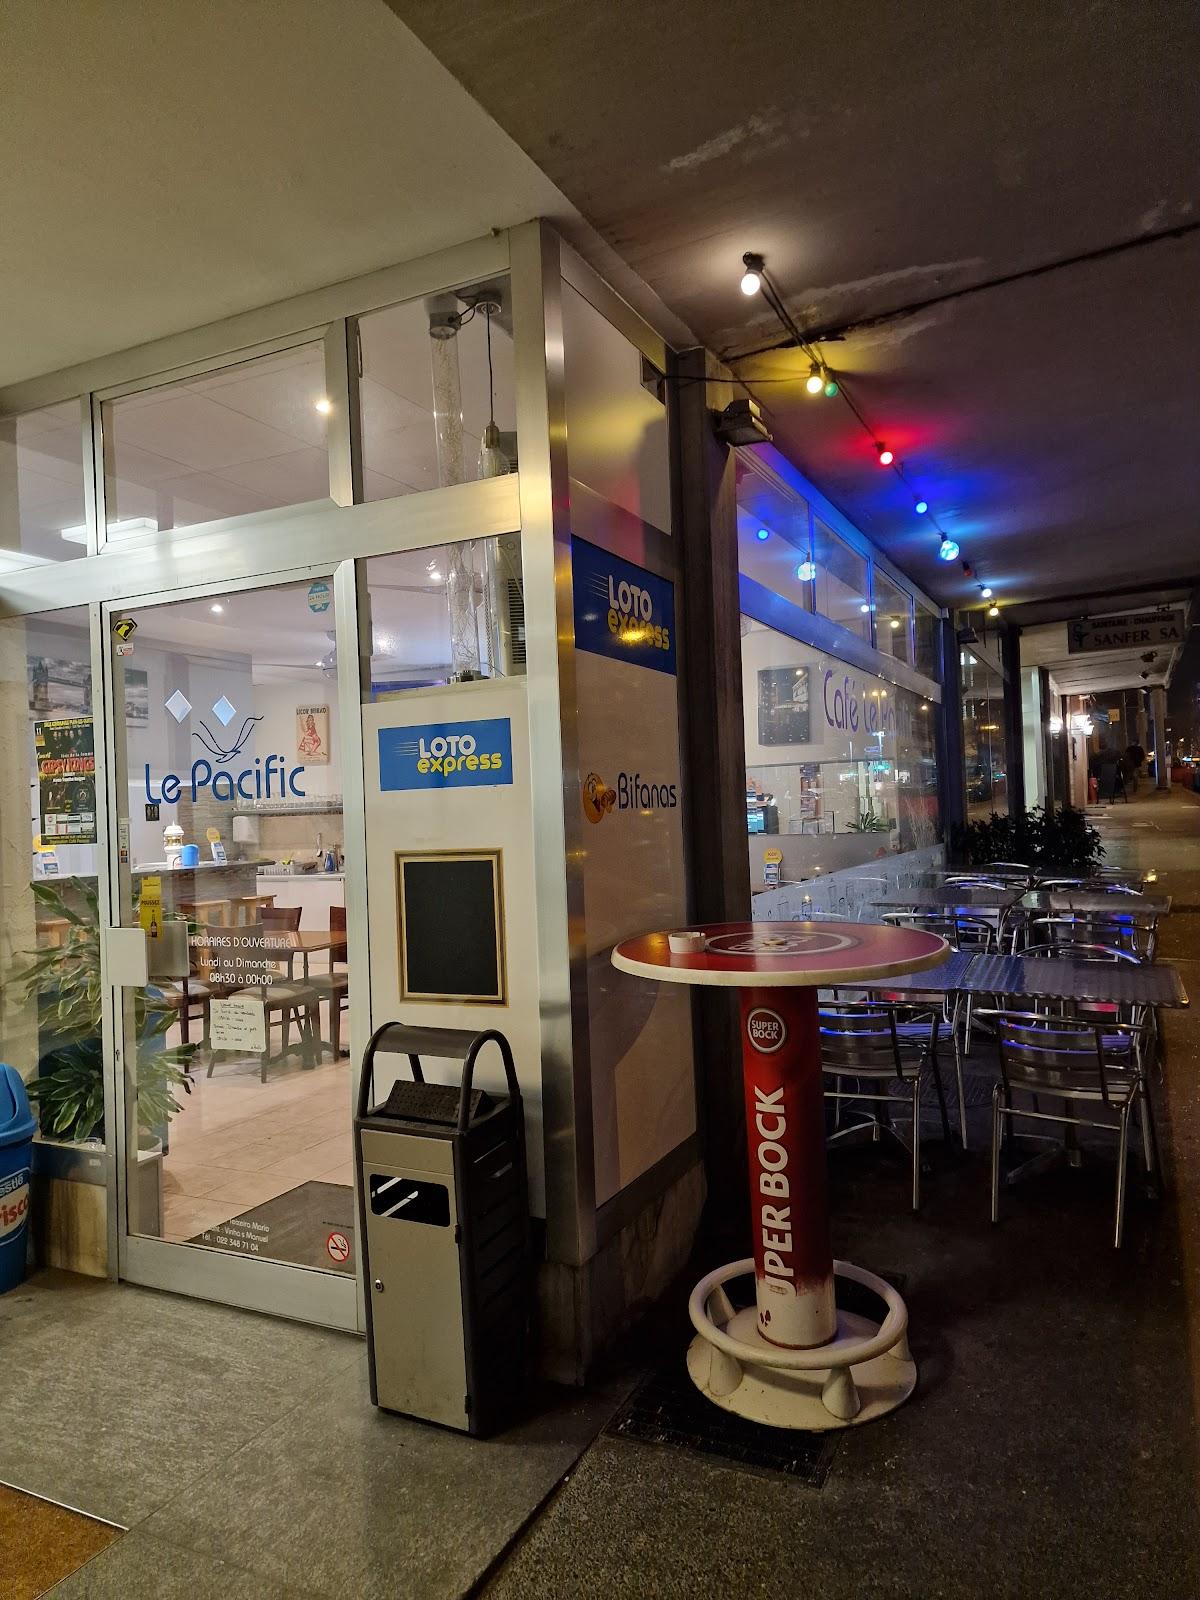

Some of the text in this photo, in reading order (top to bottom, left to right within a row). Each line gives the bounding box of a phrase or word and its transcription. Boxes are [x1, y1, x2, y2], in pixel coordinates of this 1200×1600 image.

[607, 573, 653, 620] LOTO
[607, 608, 670, 651] express
[1094, 626, 1179, 647] SANFER SA
[823, 669, 859, 733] Café
[418, 734, 476, 760] LOTO
[416, 752, 502, 777] express
[145, 754, 306, 805] Le Pacific
[617, 772, 677, 810] Bifanas
[191, 936, 292, 949] HORAIRES D'OUVERTURE
[200, 956, 277, 969] Lundi au Dimanche
[209, 972, 236, 984] 08h30
[245, 973, 273, 985] 00h00
[751, 1019, 779, 1031] SUPER
[752, 1028, 778, 1040] BOCK
[754, 1085, 798, 1299] UPER BOCK
